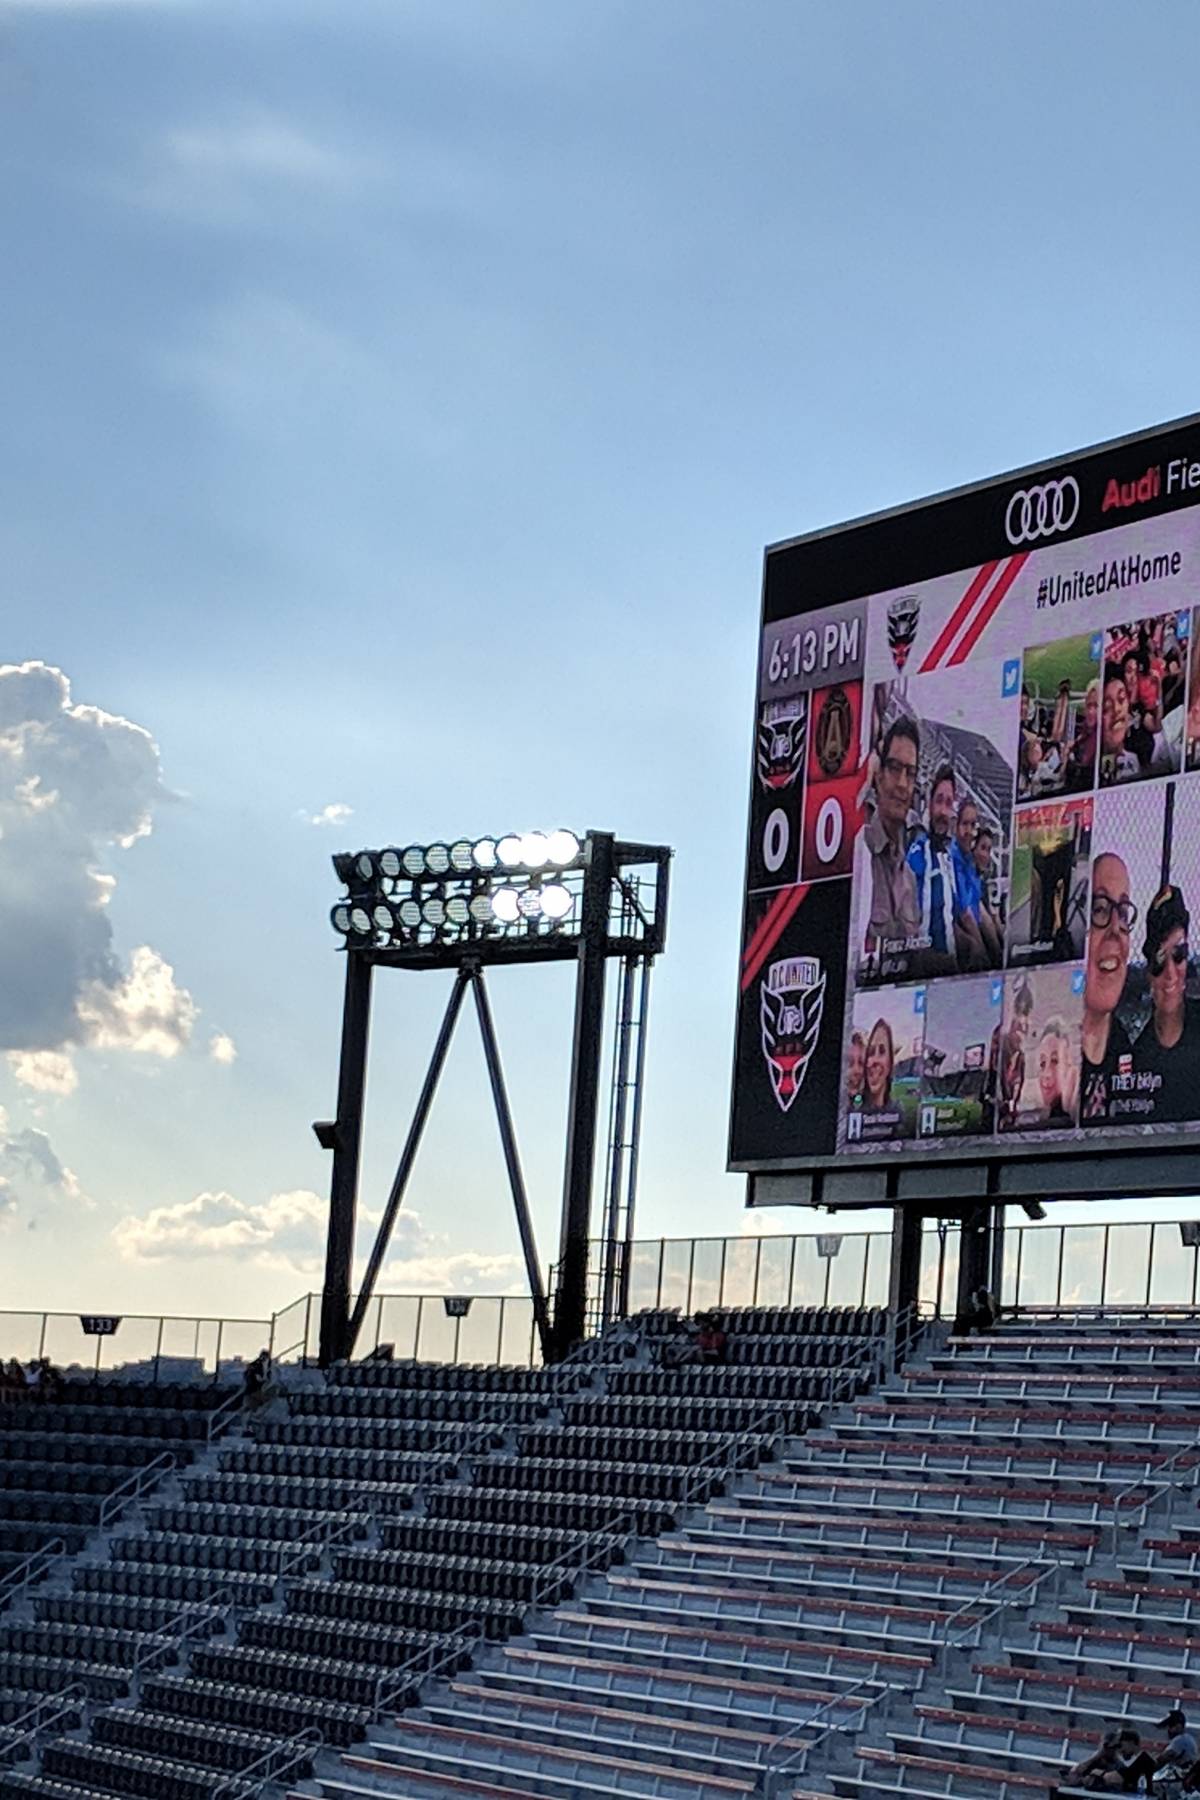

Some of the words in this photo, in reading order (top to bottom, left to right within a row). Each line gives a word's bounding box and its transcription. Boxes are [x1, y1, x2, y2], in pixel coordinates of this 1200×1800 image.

[1102, 465, 1160, 512] Audi
[1036, 551, 1182, 610] #UnitedAtHome
[769, 629, 817, 682] 6:13
[822, 618, 859, 668] PM
[763, 807, 790, 873] 0
[815, 797, 843, 863] 0
